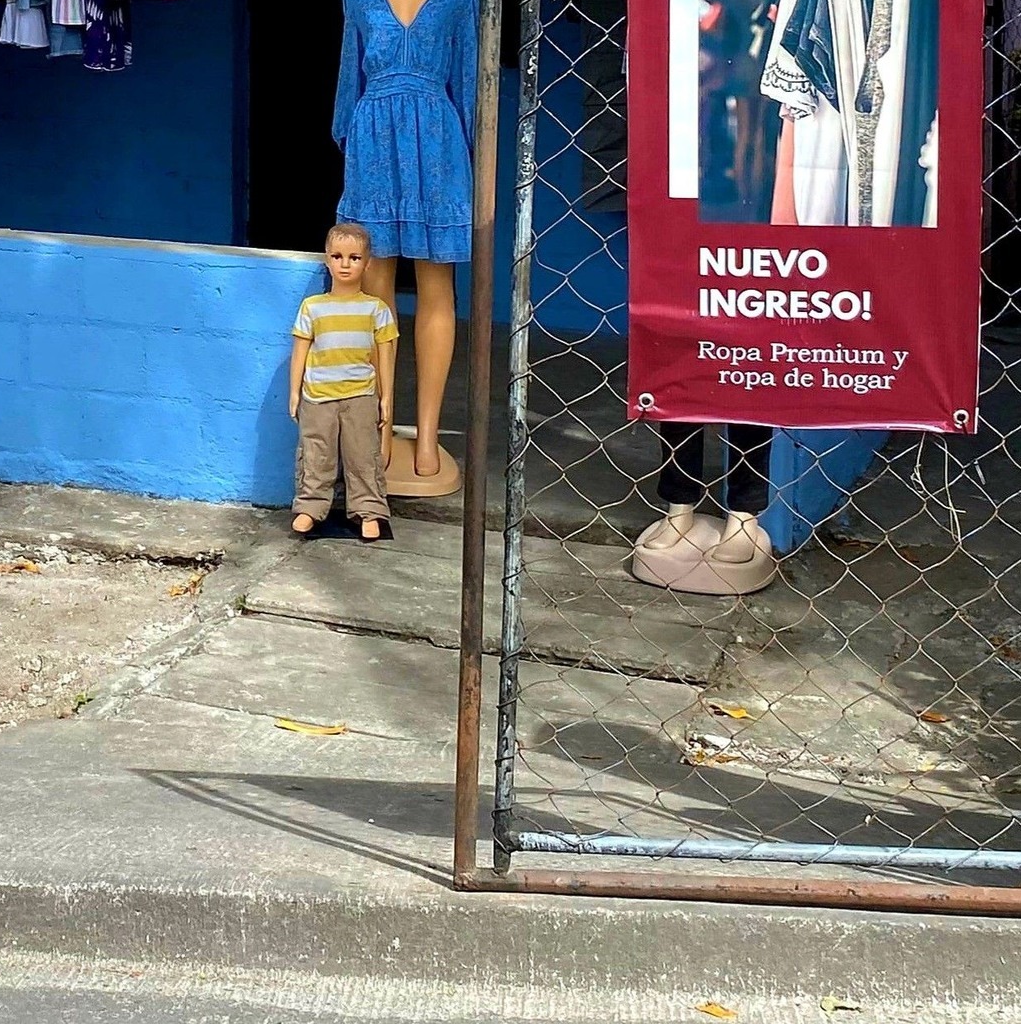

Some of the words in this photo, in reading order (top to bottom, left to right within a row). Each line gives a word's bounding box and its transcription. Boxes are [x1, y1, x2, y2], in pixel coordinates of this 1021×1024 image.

[699, 247, 828, 279] NUEVO
[699, 288, 872, 321] INGRESO!
[697, 341, 763, 366] Ropa
[770, 343, 885, 364] Premium
[892, 350, 909, 370] y
[718, 369, 776, 389] ropa
[784, 367, 814, 389] de
[822, 368, 895, 393] hogar
